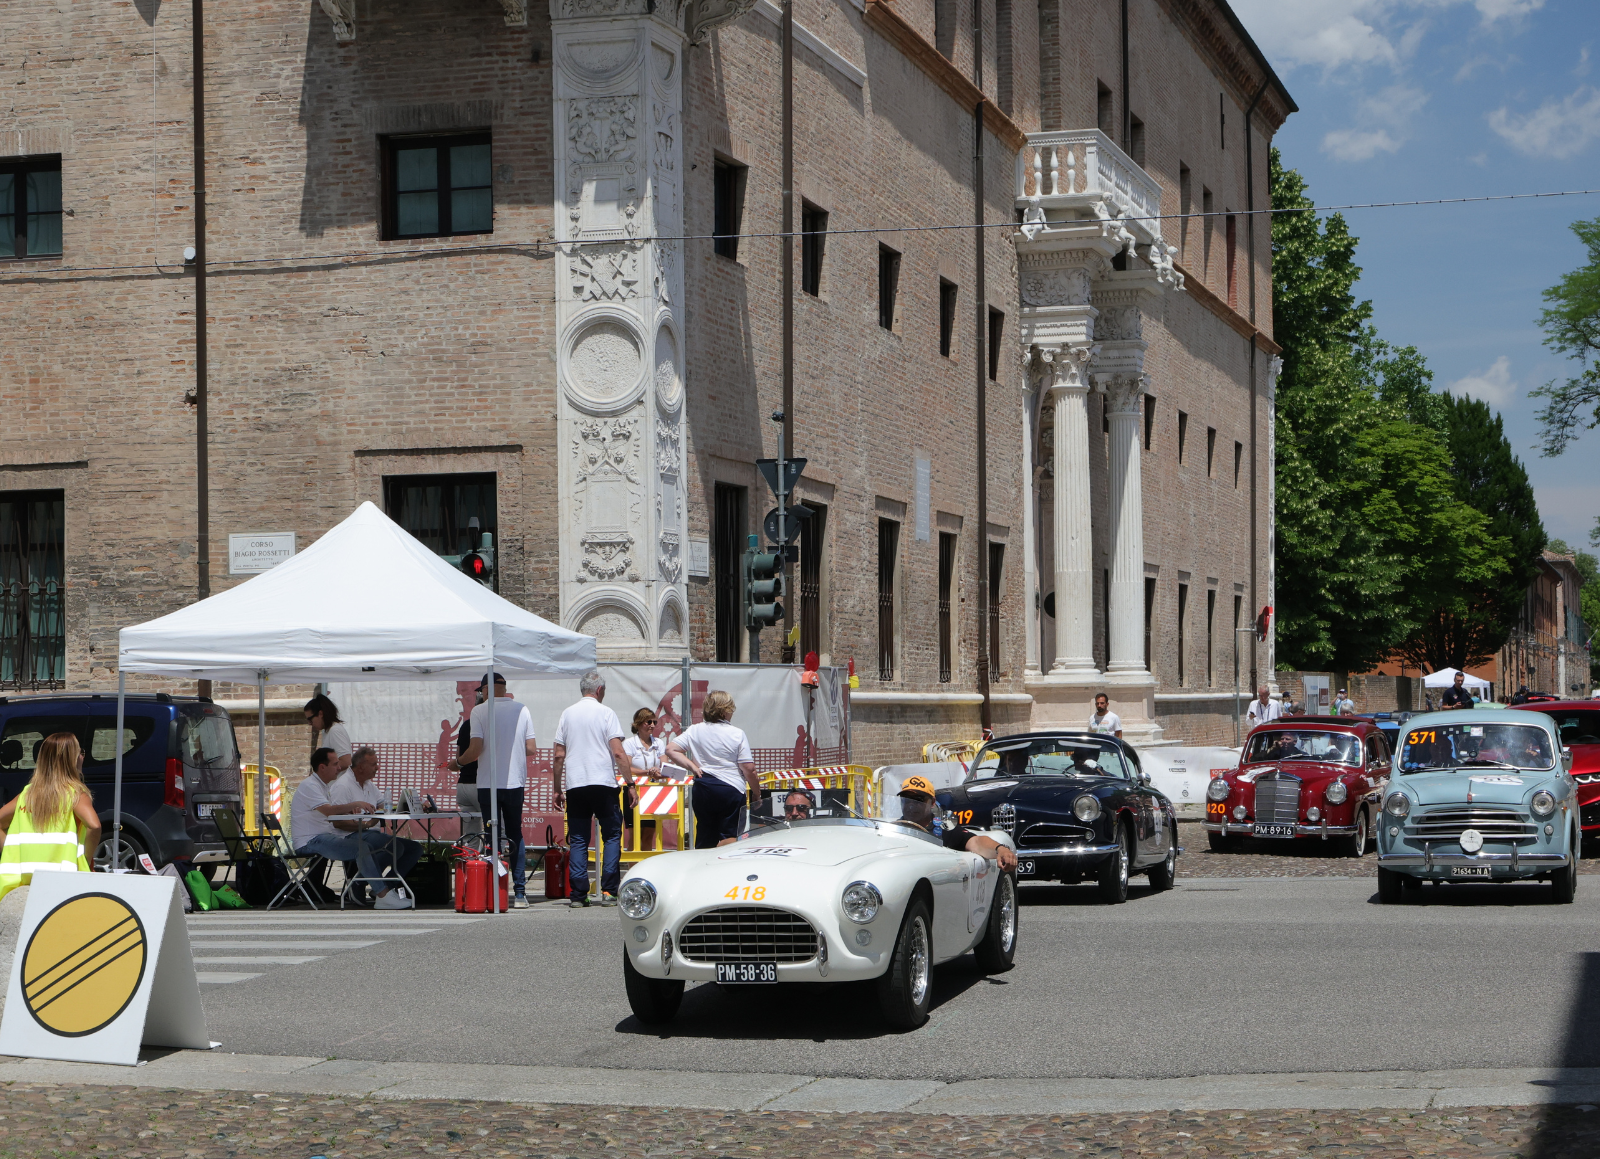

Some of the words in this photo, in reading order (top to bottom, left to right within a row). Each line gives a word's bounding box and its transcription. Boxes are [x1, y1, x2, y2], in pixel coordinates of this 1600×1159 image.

[234, 550, 257, 558] BIAGIO
[258, 549, 290, 557] ROSSETTI
[1408, 730, 1437, 745] 371
[1206, 803, 1226, 814] 420
[953, 809, 974, 825] 19
[1255, 825, 1292, 835] PM-89-16
[723, 885, 767, 901] 418
[717, 964, 776, 981] PM-58-36
